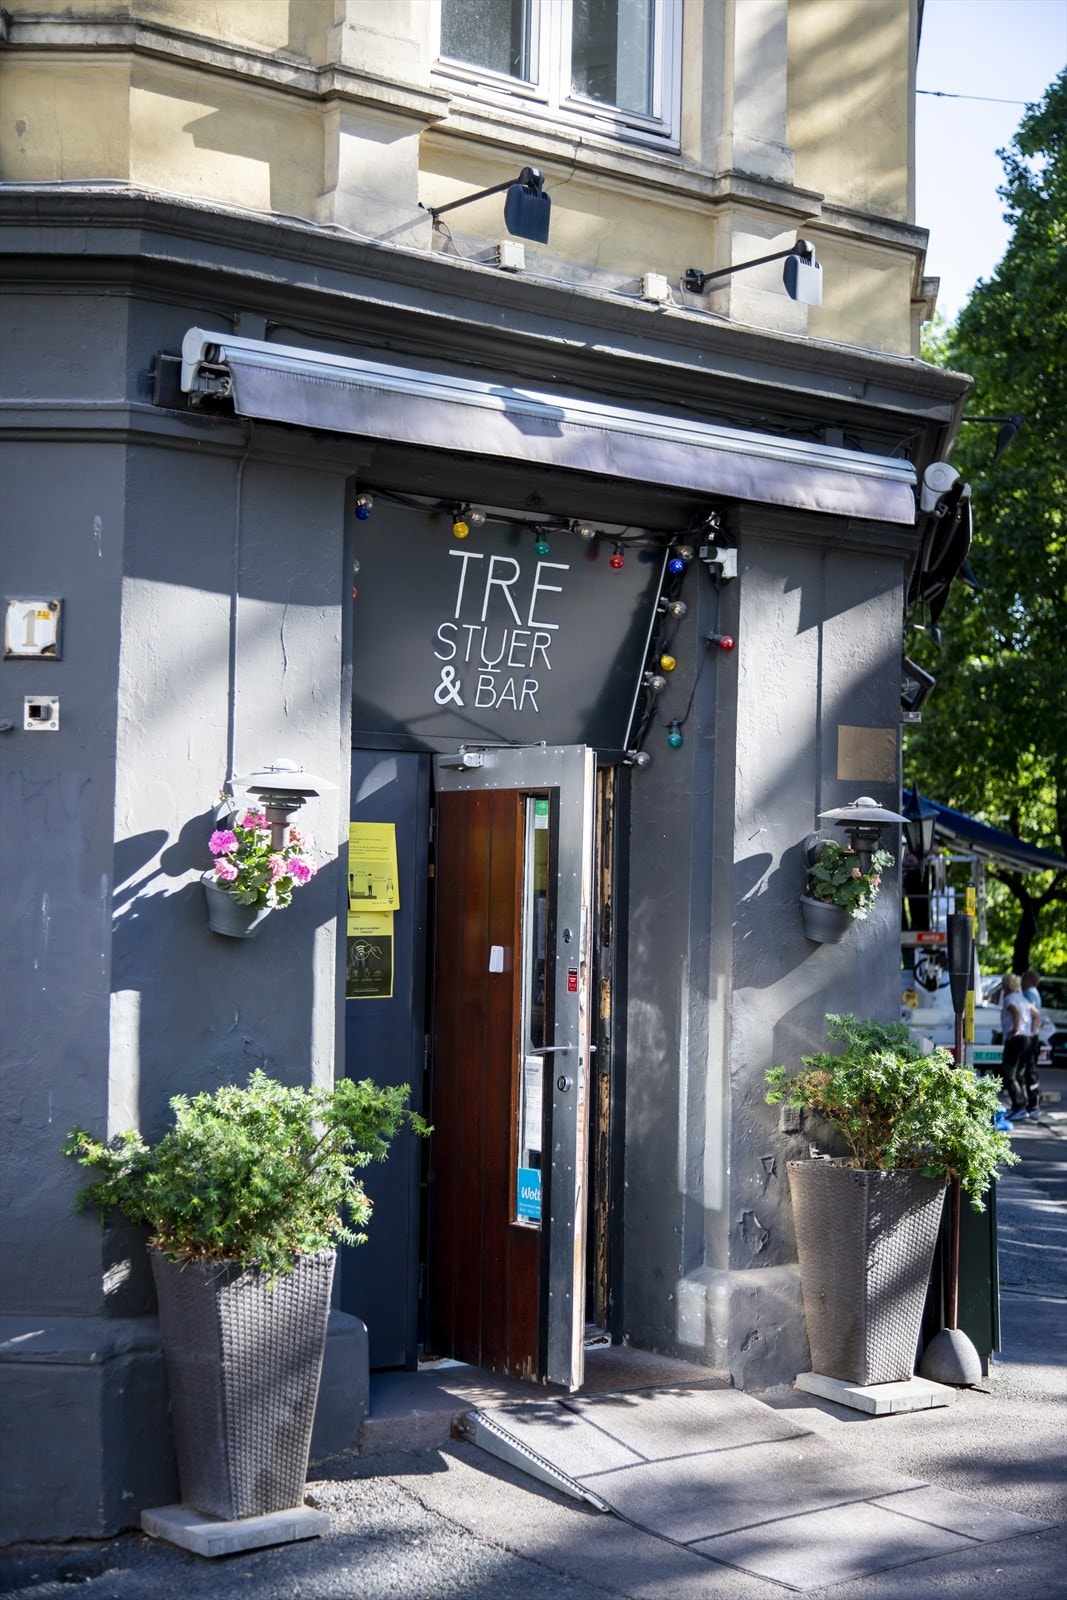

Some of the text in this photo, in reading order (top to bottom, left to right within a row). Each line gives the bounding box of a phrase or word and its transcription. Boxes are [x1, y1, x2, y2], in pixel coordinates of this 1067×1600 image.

[449, 549, 570, 630] TRE
[22, 609, 38, 647] 1
[434, 622, 552, 672] STUER
[434, 666, 539, 713] & BAR
[521, 1186, 541, 1202] Wolt
